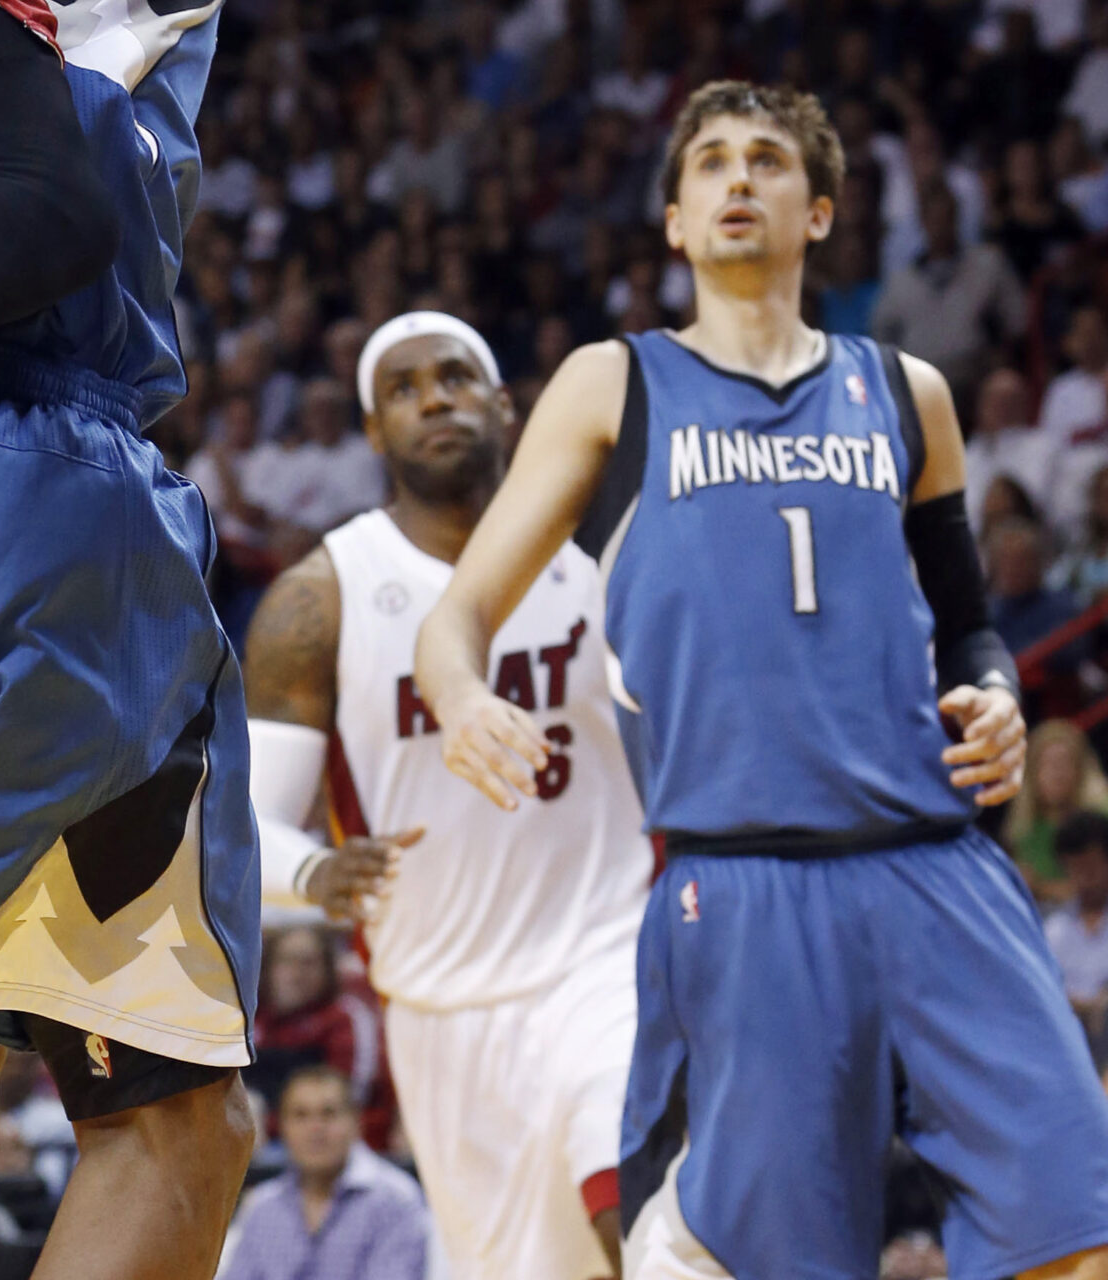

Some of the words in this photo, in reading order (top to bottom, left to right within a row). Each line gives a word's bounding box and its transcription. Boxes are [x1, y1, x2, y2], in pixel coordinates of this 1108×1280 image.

[669, 423, 902, 503] MINNESOTA
[778, 505, 819, 615] 1
[396, 616, 588, 739] HAT
[534, 723, 574, 802] 6
